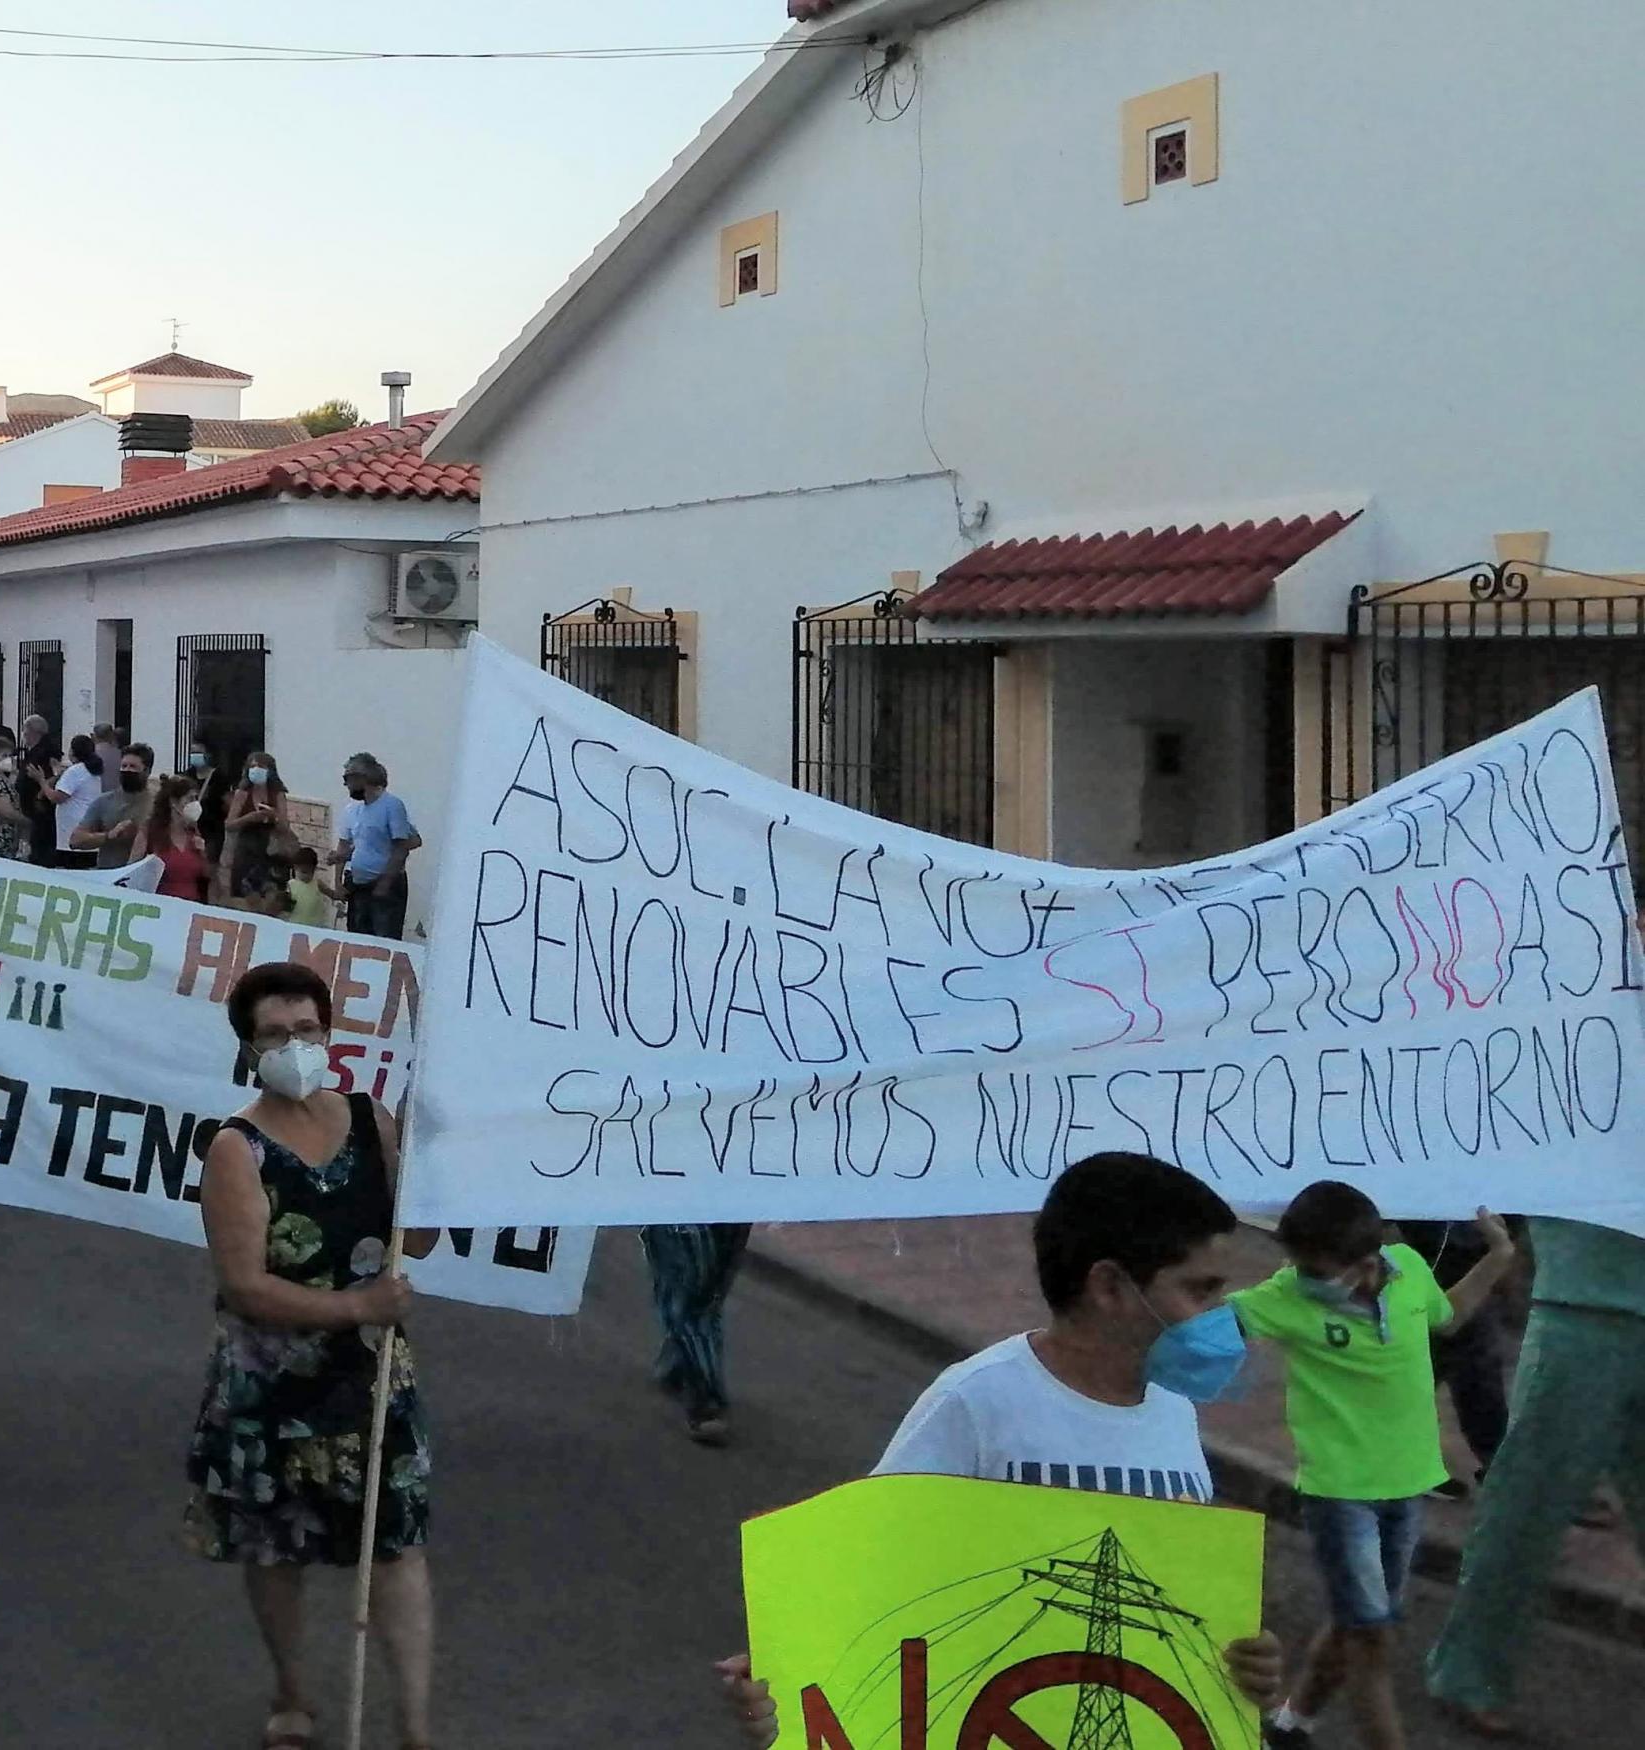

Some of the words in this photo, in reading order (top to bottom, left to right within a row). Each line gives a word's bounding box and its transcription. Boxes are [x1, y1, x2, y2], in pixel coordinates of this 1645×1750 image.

[493, 717, 746, 905] ASOC.
[768, 815, 892, 946] LA
[1197, 886, 1401, 1038] PERO
[1395, 877, 1504, 1020] NO
[530, 1069, 936, 1178] SALVEMOS
[973, 1055, 1297, 1181] NUESTRO
[1318, 1016, 1622, 1168] ENTORNO
